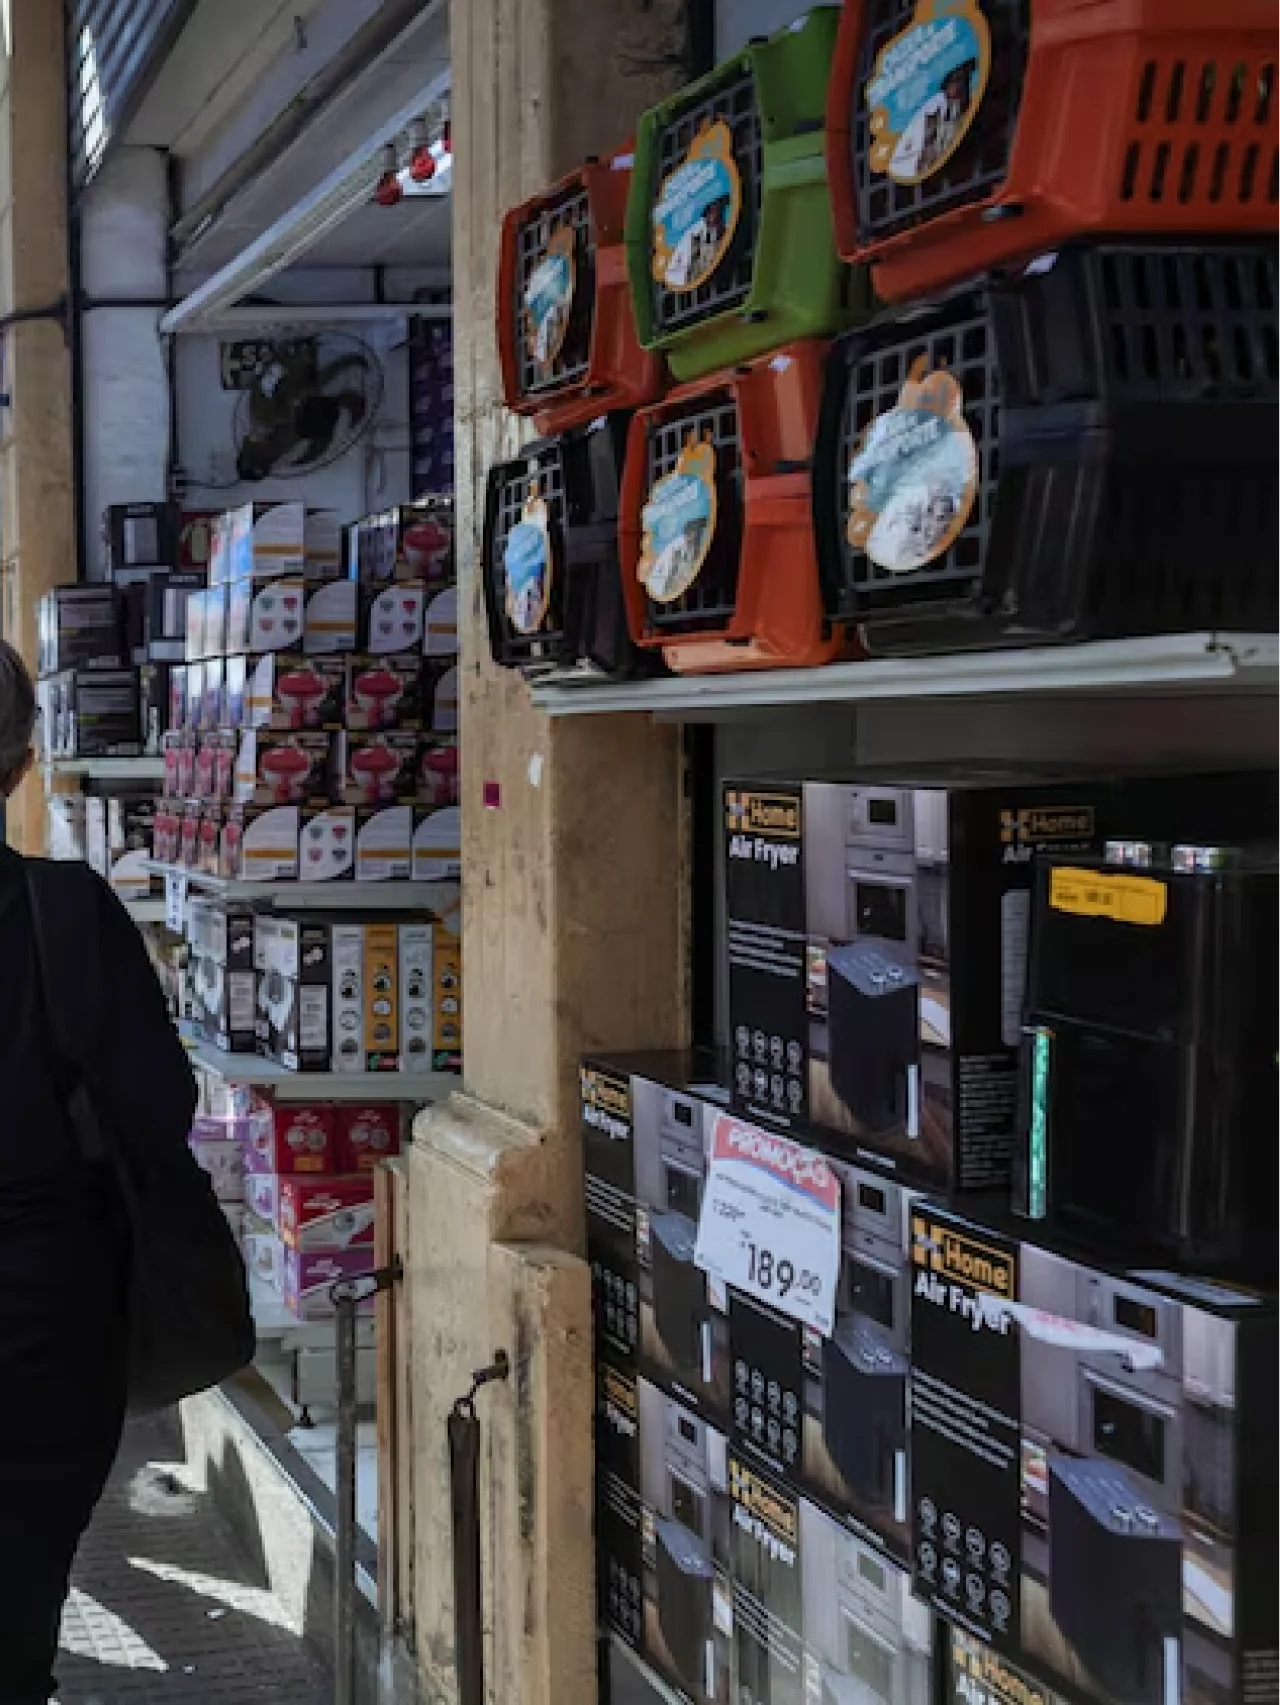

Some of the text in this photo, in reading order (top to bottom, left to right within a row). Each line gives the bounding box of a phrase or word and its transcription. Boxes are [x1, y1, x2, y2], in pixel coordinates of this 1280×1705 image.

[729, 835, 799, 870] Air Fryer
[946, 1238, 1008, 1290] Home
[914, 1270, 946, 1306] Air
